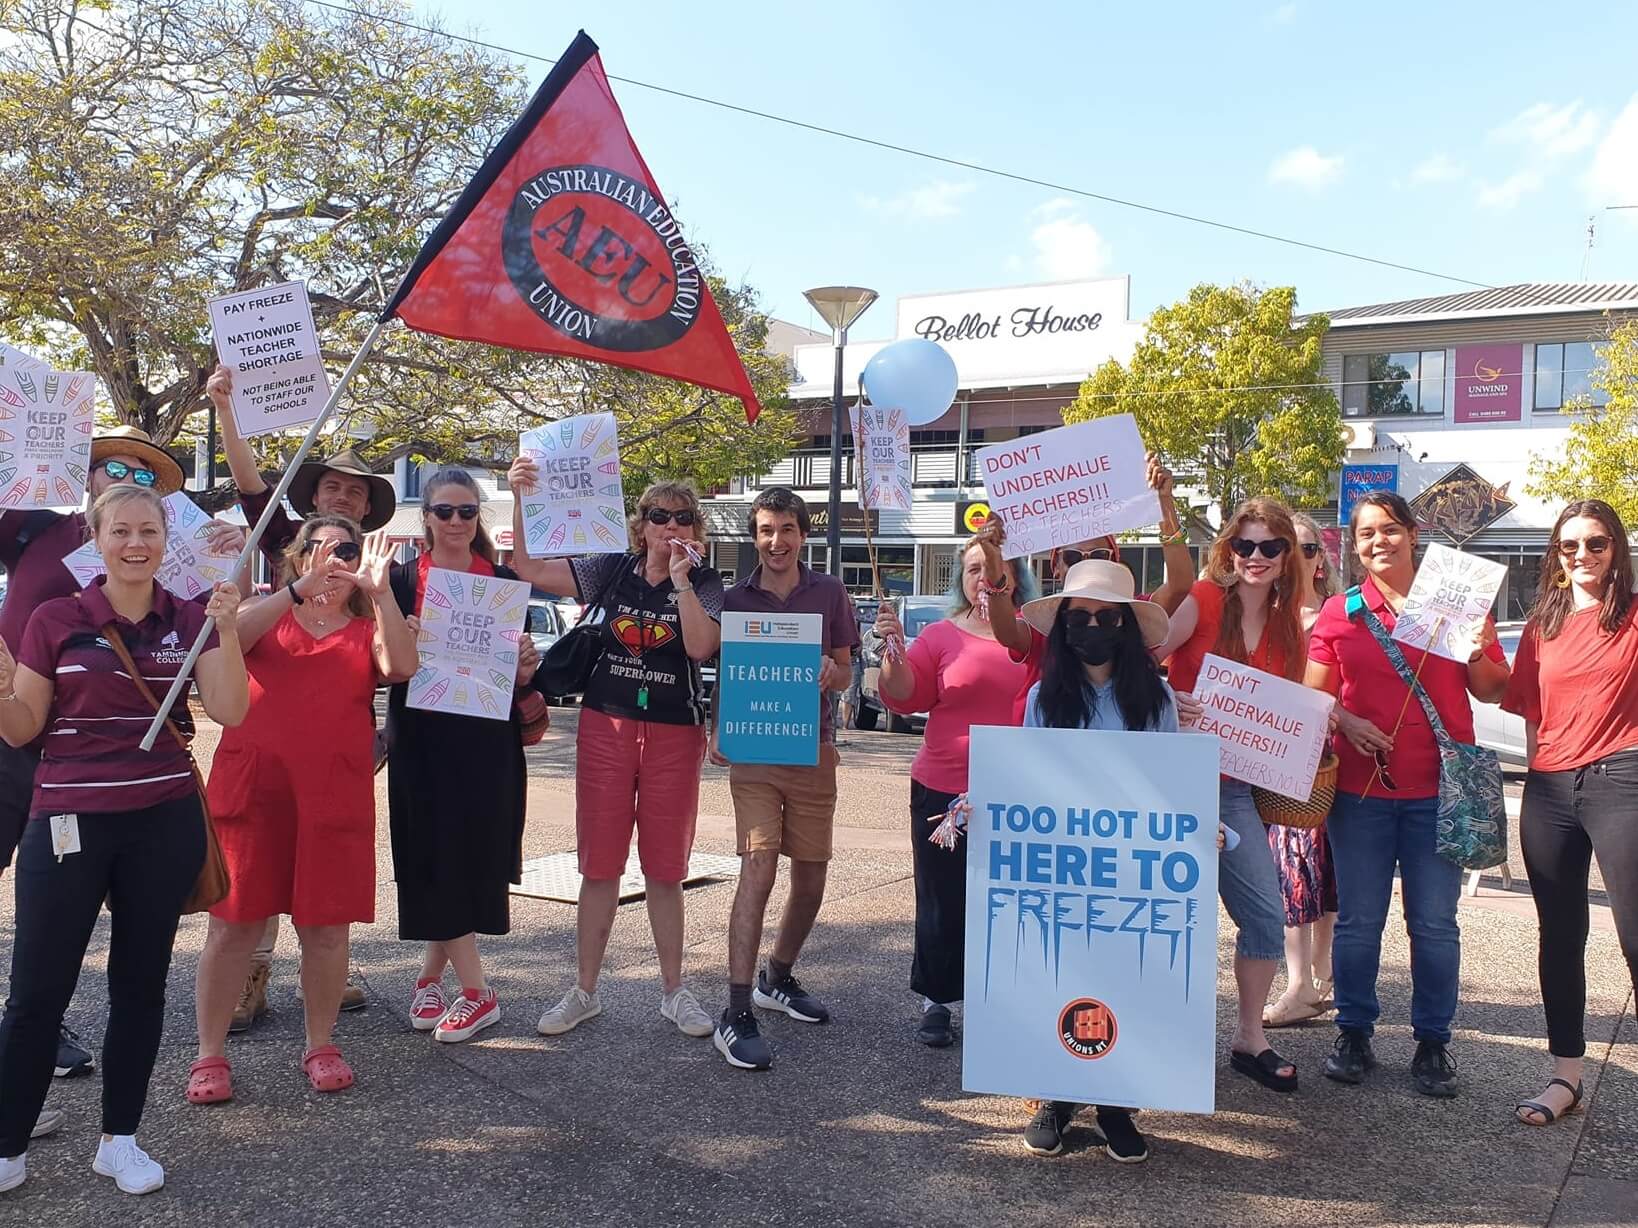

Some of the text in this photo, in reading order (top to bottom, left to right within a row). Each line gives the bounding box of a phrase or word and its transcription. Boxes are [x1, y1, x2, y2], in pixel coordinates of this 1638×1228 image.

[521, 169, 700, 326] AUSTRALIAN EDUCATION
[534, 206, 671, 307] AEU
[224, 292, 294, 315] PAY FREEZE
[529, 281, 598, 339] UNION
[915, 305, 1103, 342] Bellot House
[228, 321, 302, 346] NATIONWIDE
[240, 338, 295, 357] TEACHER
[239, 350, 304, 372] SHORTAGE
[242, 373, 317, 396] NOT BEING ABLE
[1468, 384, 1508, 393] UNWIND
[251, 385, 314, 405] TO STAFF OUR
[263, 397, 307, 414] SCHOOLS
[27, 410, 67, 425] KEEP
[26, 425, 66, 441] OUR
[871, 436, 894, 447] KEEP
[24, 440, 65, 448] TEACHERS
[872, 447, 895, 458] OUR
[546, 456, 591, 474] KEEP
[986, 444, 1042, 473] DON'T
[548, 472, 594, 491] OUR
[993, 455, 1112, 498] UNDERVALUE
[1346, 470, 1392, 484] PARAP
[549, 489, 595, 501] TEACHERS
[998, 483, 1109, 524] TEACHERS!!!
[1006, 521, 1029, 535] NO
[1040, 500, 1122, 529] TEACHERS
[1009, 518, 1113, 554] NO FUTURE
[1440, 576, 1472, 594] KEEP
[1436, 588, 1467, 607] OUR
[450, 610, 495, 629] KEEP
[642, 610, 678, 622] TEAHER
[447, 626, 492, 647] OUR
[744, 620, 772, 634] IEU
[446, 641, 490, 655] TEACHERS
[728, 665, 814, 683] TEACHERS
[1207, 665, 1261, 695] DON'T
[750, 701, 792, 713] MAKE A
[1200, 689, 1304, 737] UNDERVALUE
[726, 721, 813, 737] DIFFERENCE!
[987, 803, 1199, 842] TOO HOT UP
[989, 840, 1200, 893] HERE TO
[1063, 1032, 1108, 1055] UNIONS NT
